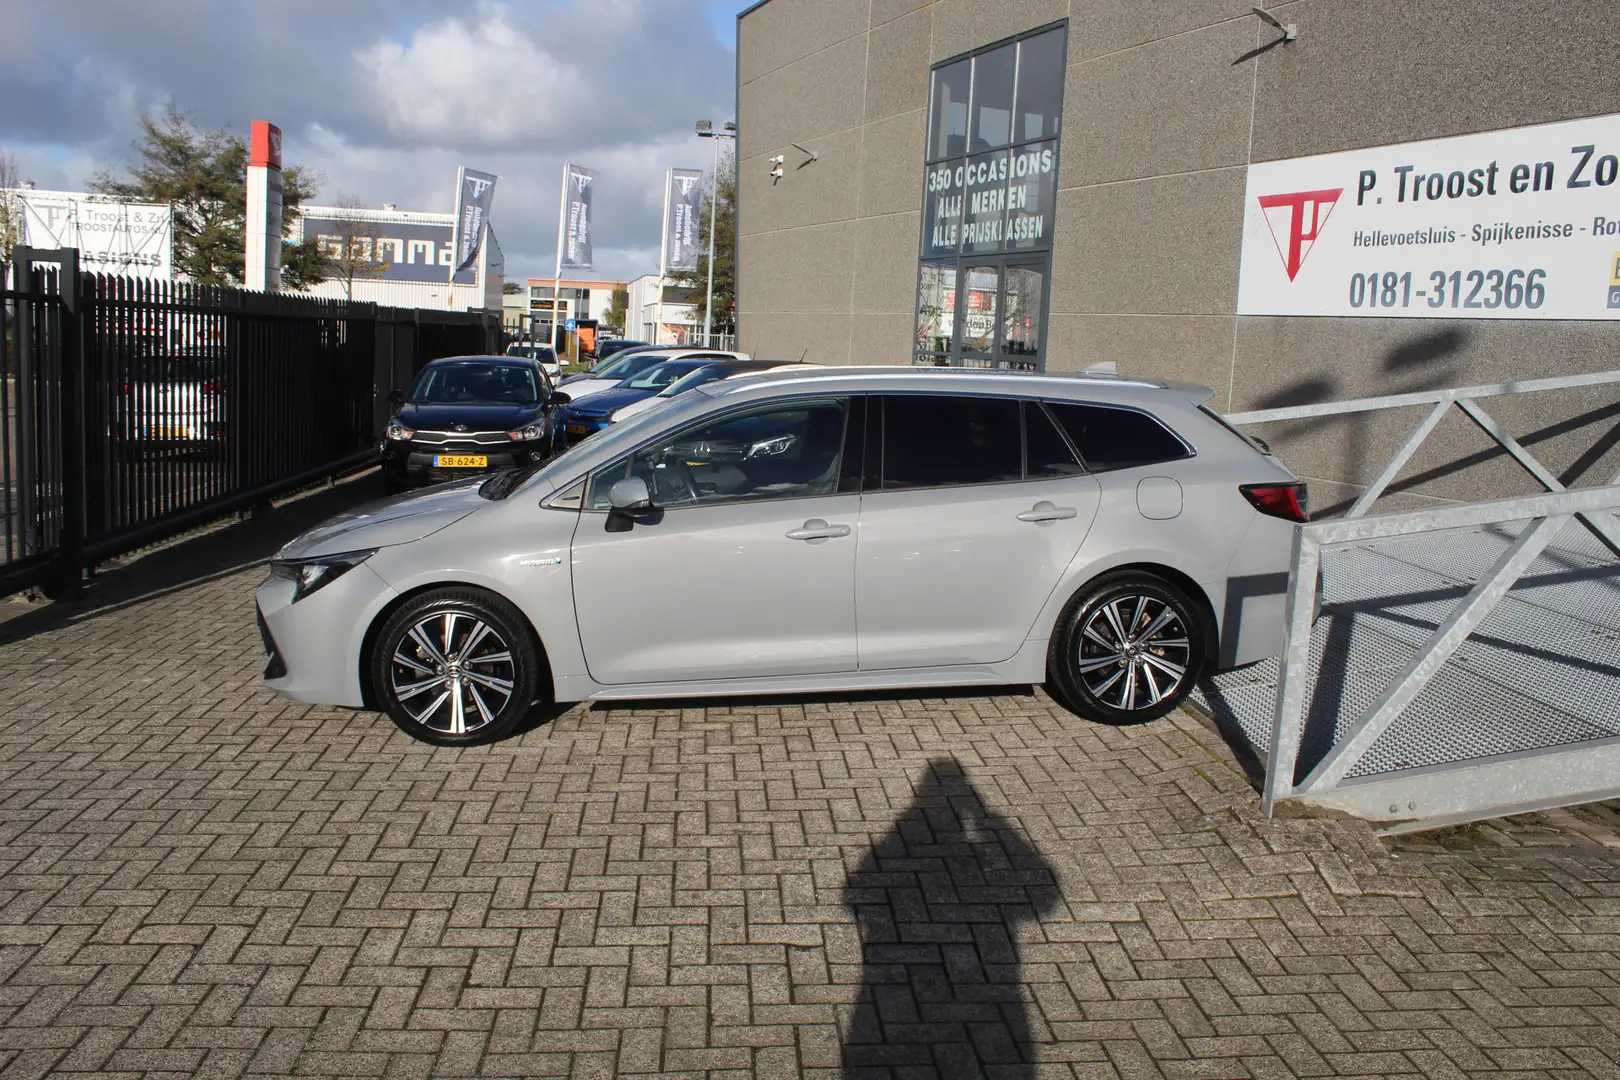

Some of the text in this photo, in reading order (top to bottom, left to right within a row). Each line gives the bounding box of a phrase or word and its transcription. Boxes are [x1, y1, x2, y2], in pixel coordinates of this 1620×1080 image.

[929, 149, 1052, 192] 350 OCCASIONS
[1357, 170, 1382, 206] P.
[1394, 159, 1499, 203] Troost
[1509, 159, 1554, 195] en
[971, 185, 1026, 214] MERKEN
[932, 224, 956, 247] ALLE
[1353, 225, 1455, 247] Hellevoetsluis
[1471, 222, 1573, 247] Spijkenisse
[1349, 268, 1547, 309] 0181-312366
[441, 457, 484, 466] SB-624-Z
